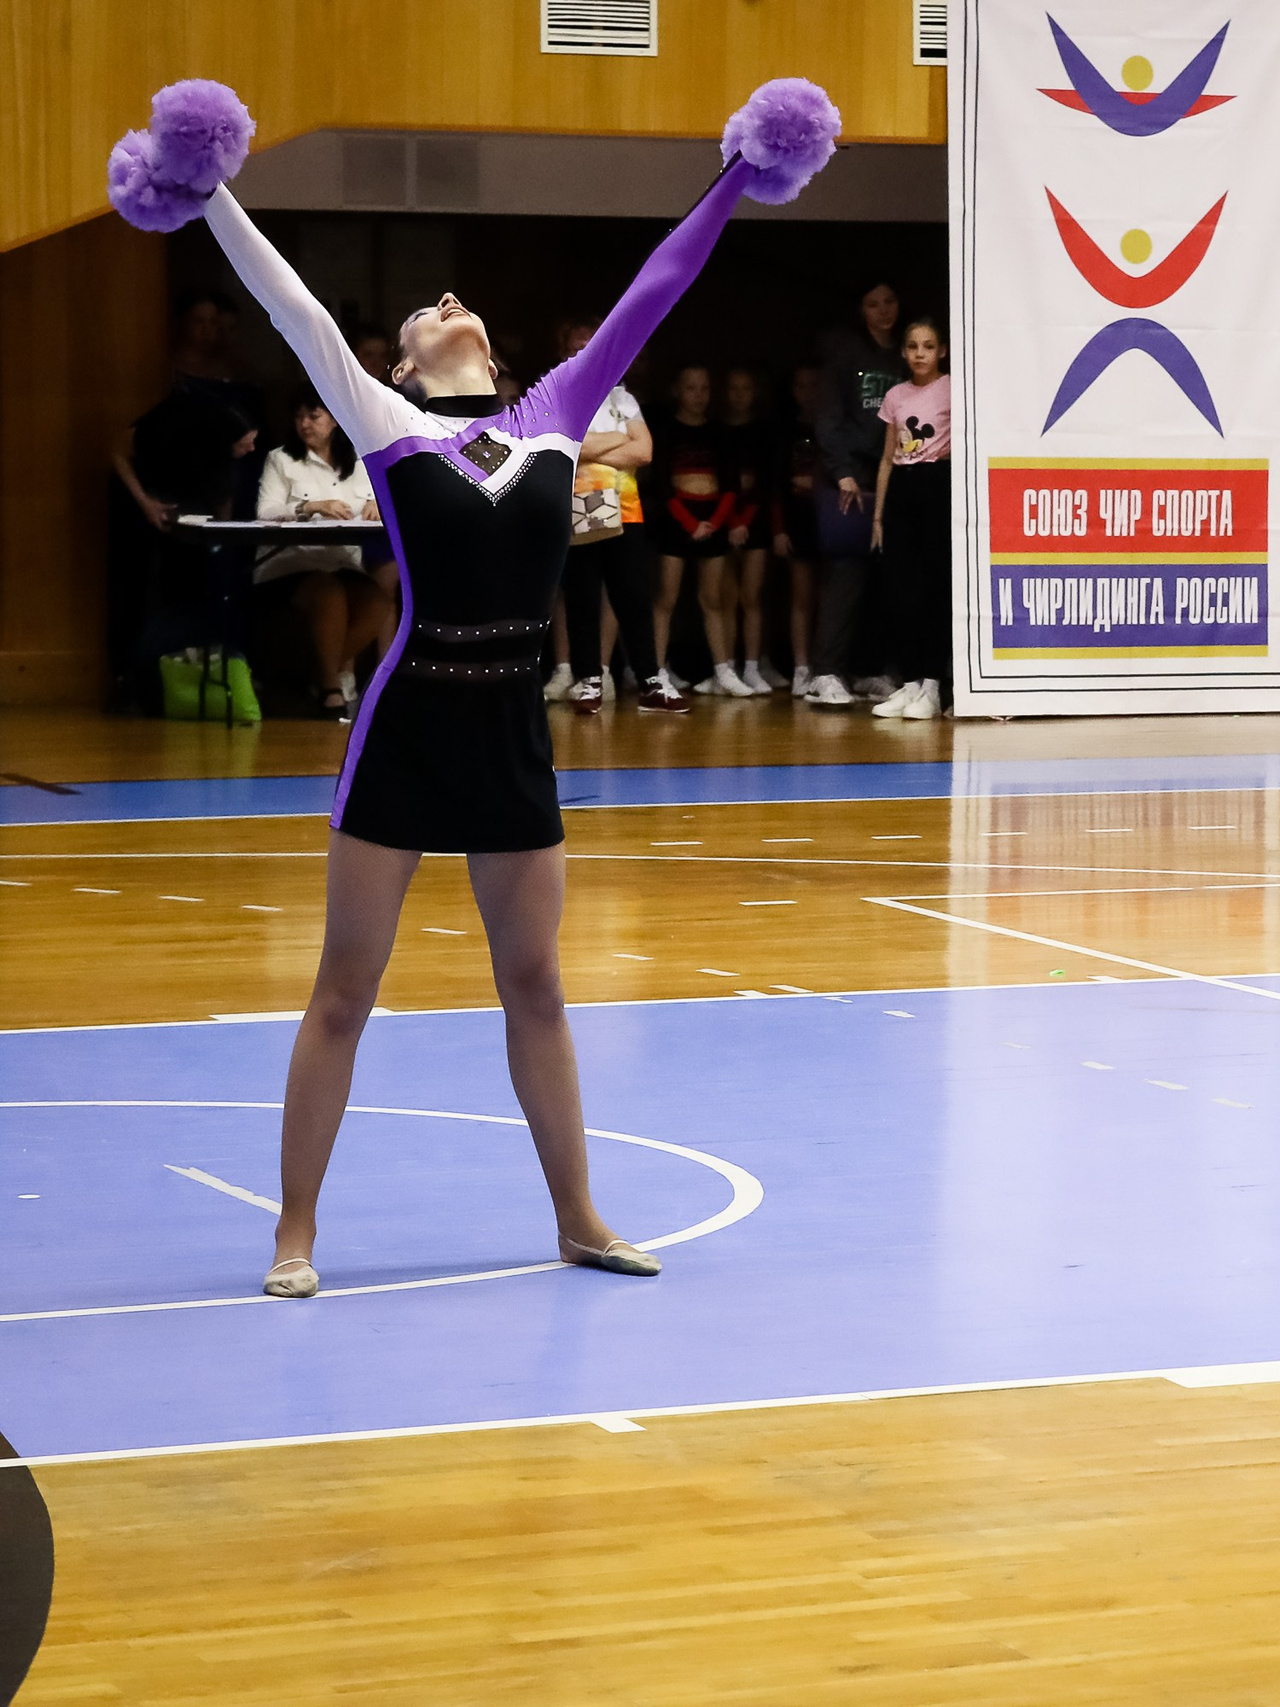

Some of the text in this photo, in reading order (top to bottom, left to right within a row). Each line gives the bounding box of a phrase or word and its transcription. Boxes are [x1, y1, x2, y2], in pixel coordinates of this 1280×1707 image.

[1022, 488, 1233, 537] СОЮЗ ЧИР СПОРТА
[998, 576, 1259, 633] И ЧИРЛИДИНГА РОССИИ
